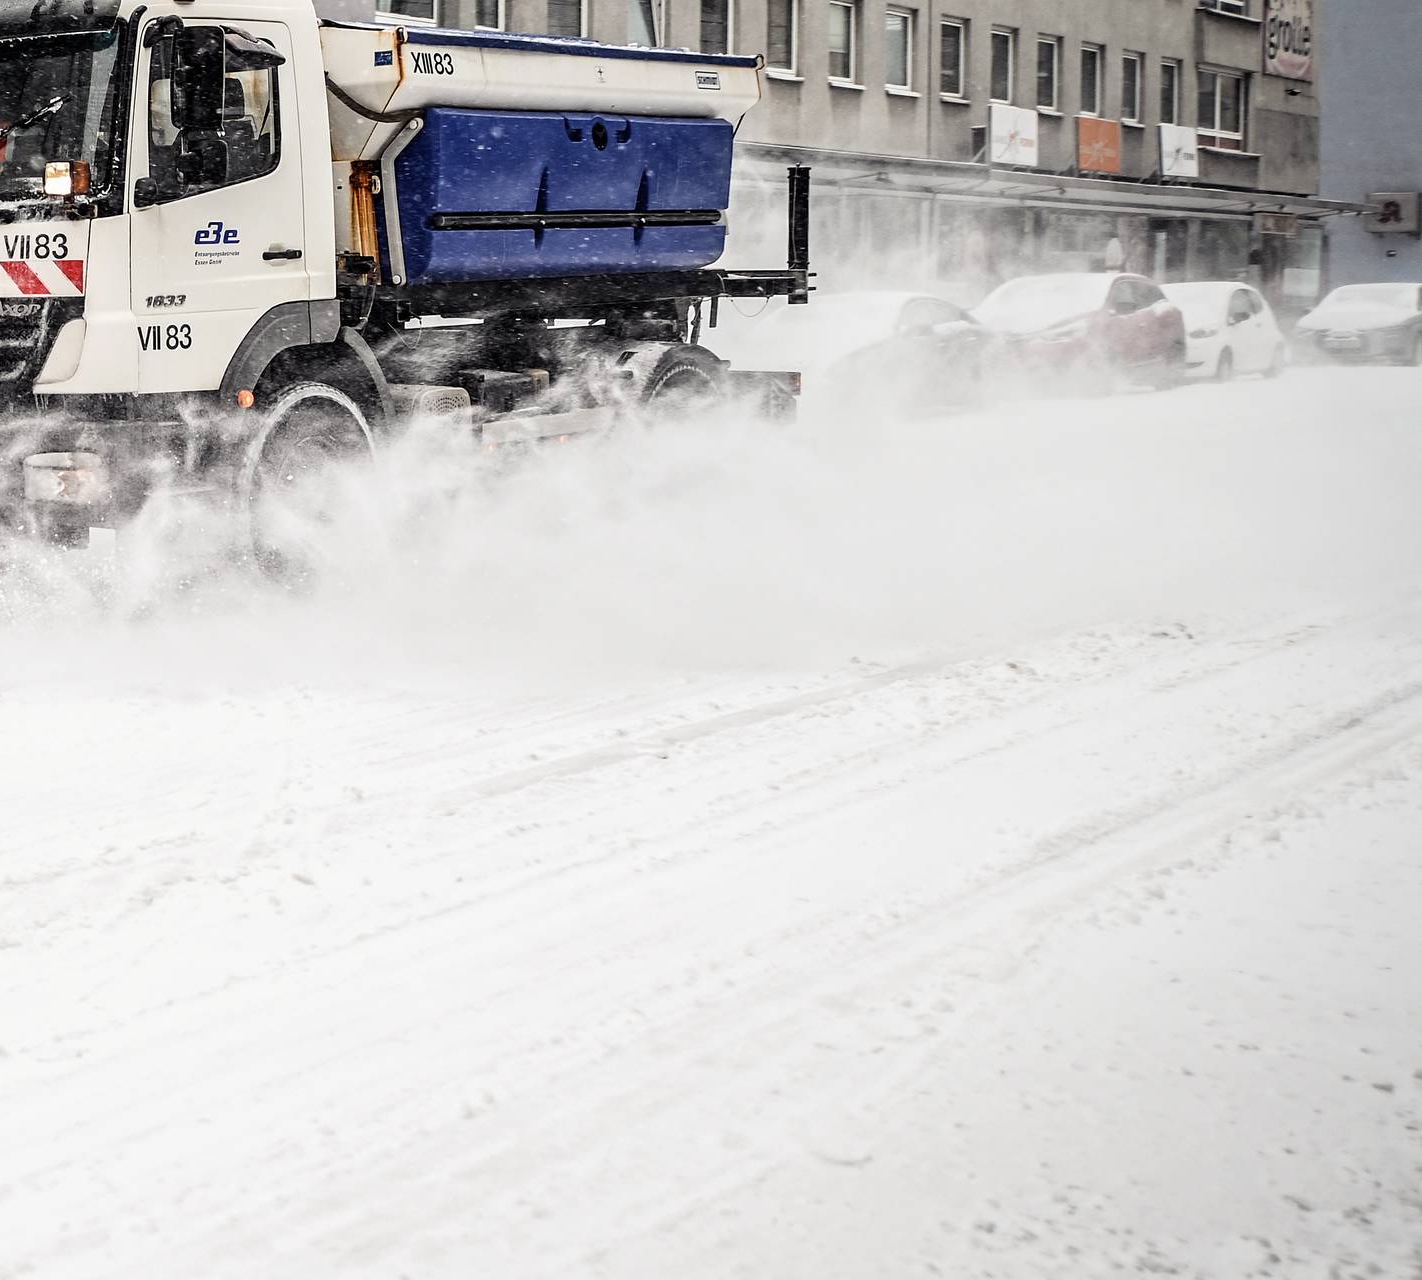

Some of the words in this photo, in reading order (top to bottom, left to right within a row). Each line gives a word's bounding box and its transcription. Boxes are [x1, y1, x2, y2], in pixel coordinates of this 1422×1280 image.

[145, 294, 187, 308] 1833
[137, 325, 161, 351] VII
[165, 323, 192, 350] 83
